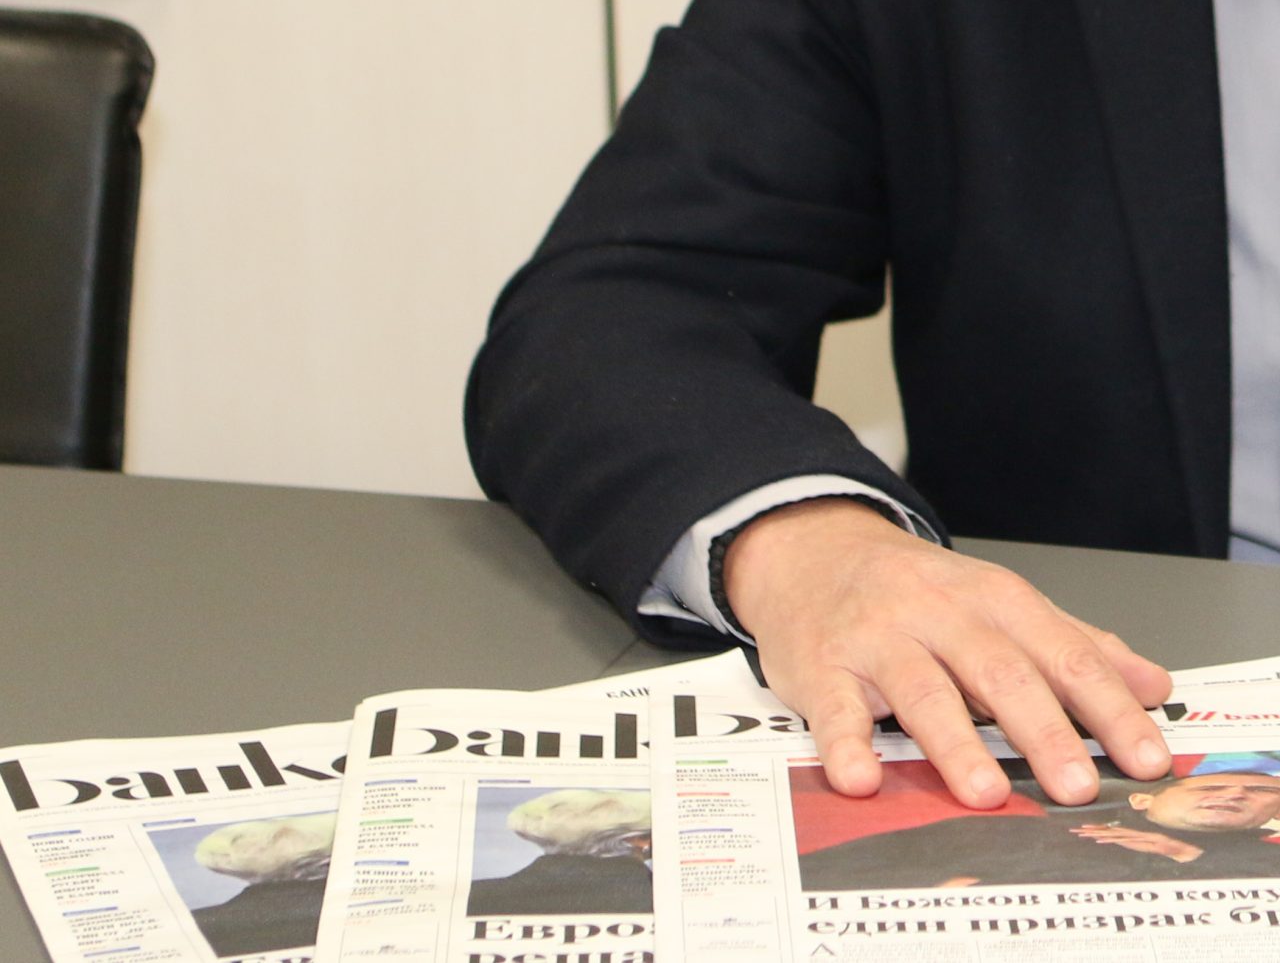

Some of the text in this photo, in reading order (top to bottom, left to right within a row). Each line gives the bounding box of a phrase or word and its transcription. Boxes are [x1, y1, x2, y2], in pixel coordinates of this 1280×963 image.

[805, 896, 841, 911] И
[858, 894, 1041, 911] Божков
[1055, 890, 1159, 905] като
[467, 919, 654, 945] Евро
[807, 920, 950, 938] един
[968, 912, 1211, 935] призрак
